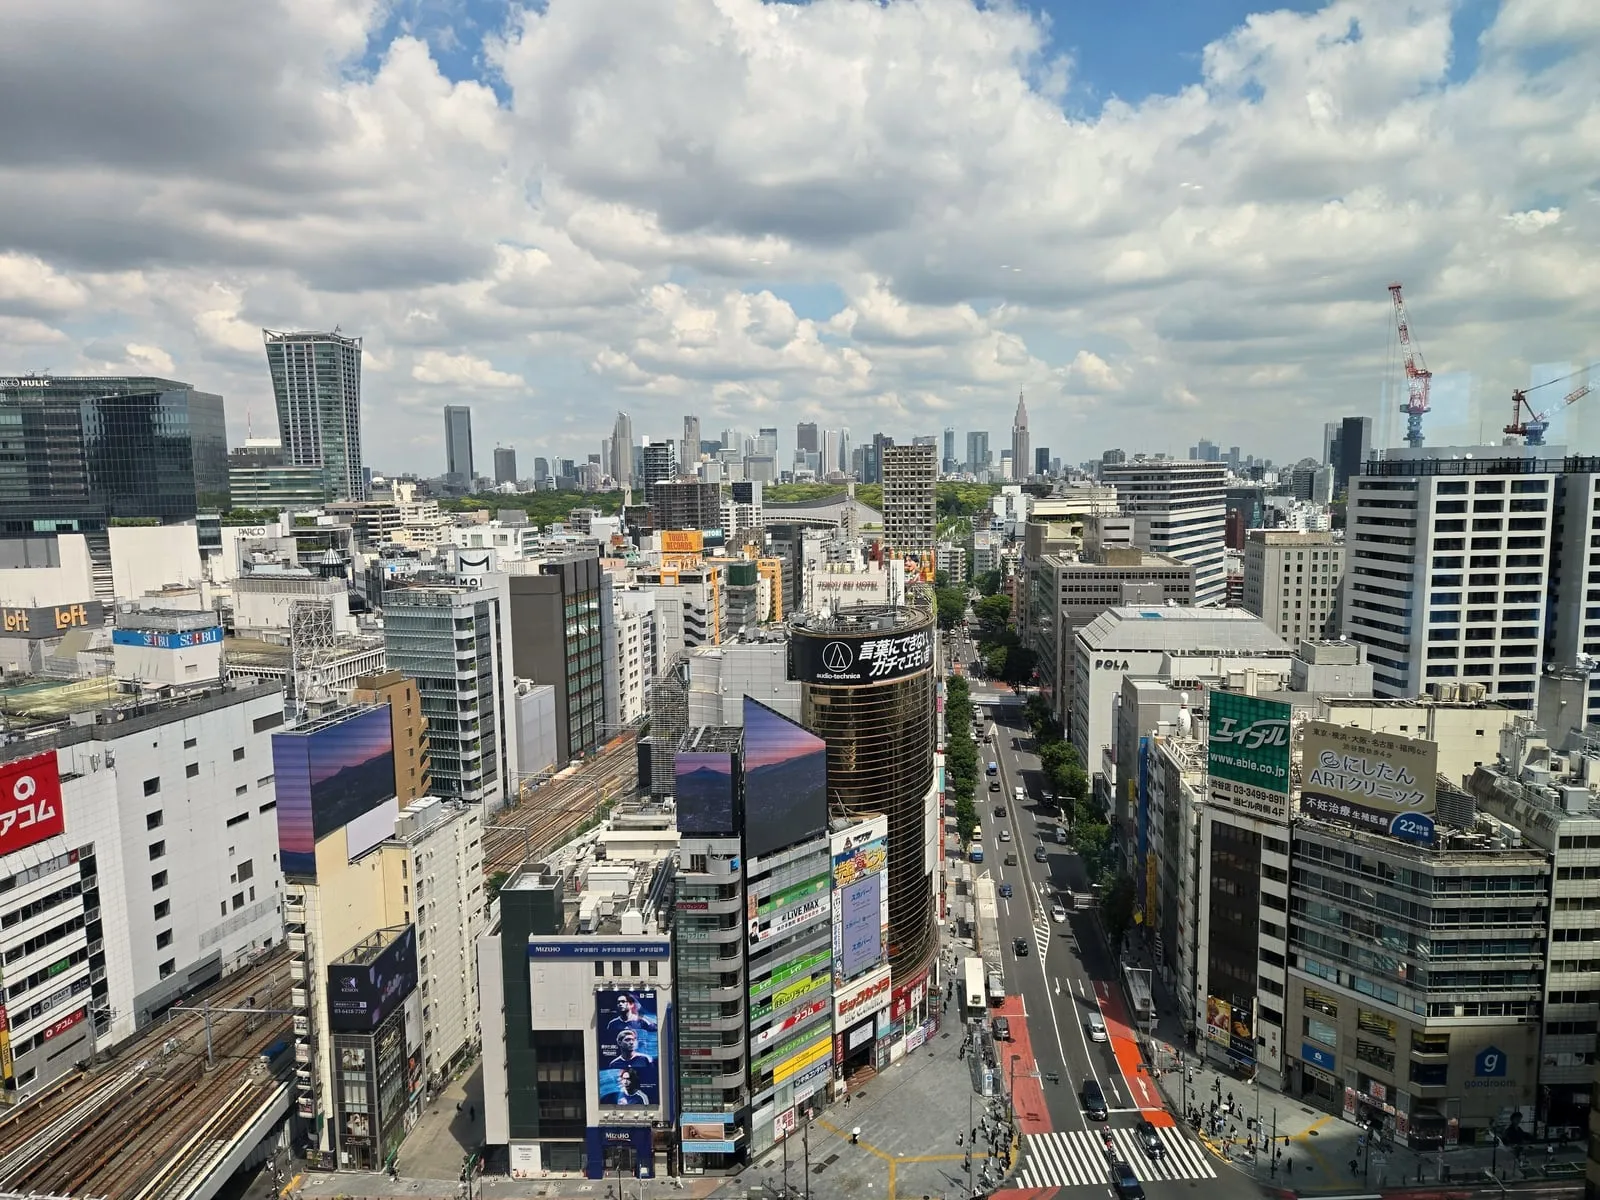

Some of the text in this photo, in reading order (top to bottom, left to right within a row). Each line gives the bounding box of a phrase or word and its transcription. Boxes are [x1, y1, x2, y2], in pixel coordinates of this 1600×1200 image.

[21, 379, 50, 387] HULIC
[238, 527, 266, 536] PARCO
[668, 533, 689, 541] TOWER
[666, 541, 693, 550] RECORDS
[817, 581, 841, 591] TOKYU
[855, 581, 879, 591] HOTEL
[143, 633, 170, 648] SEIBU
[180, 631, 217, 647] SEIBU
[1095, 659, 1130, 671] POLA
[816, 672, 861, 680] audio-technica
[1209, 717, 1290, 749] エイブル
[1210, 752, 1286, 778] www.able.co.jp
[1343, 756, 1415, 785] にしたん
[1233, 785, 1286, 806] 03-3499-8911
[1306, 797, 1351, 817] 不妊治療
[0, 799, 56, 837] アコム
[803, 899, 820, 913] MAX
[838, 976, 890, 1016] ビックカメラ
[794, 1008, 814, 1024] アコム
[55, 1019, 73, 1033] アコム
[1464, 1078, 1517, 1089] goodroom
